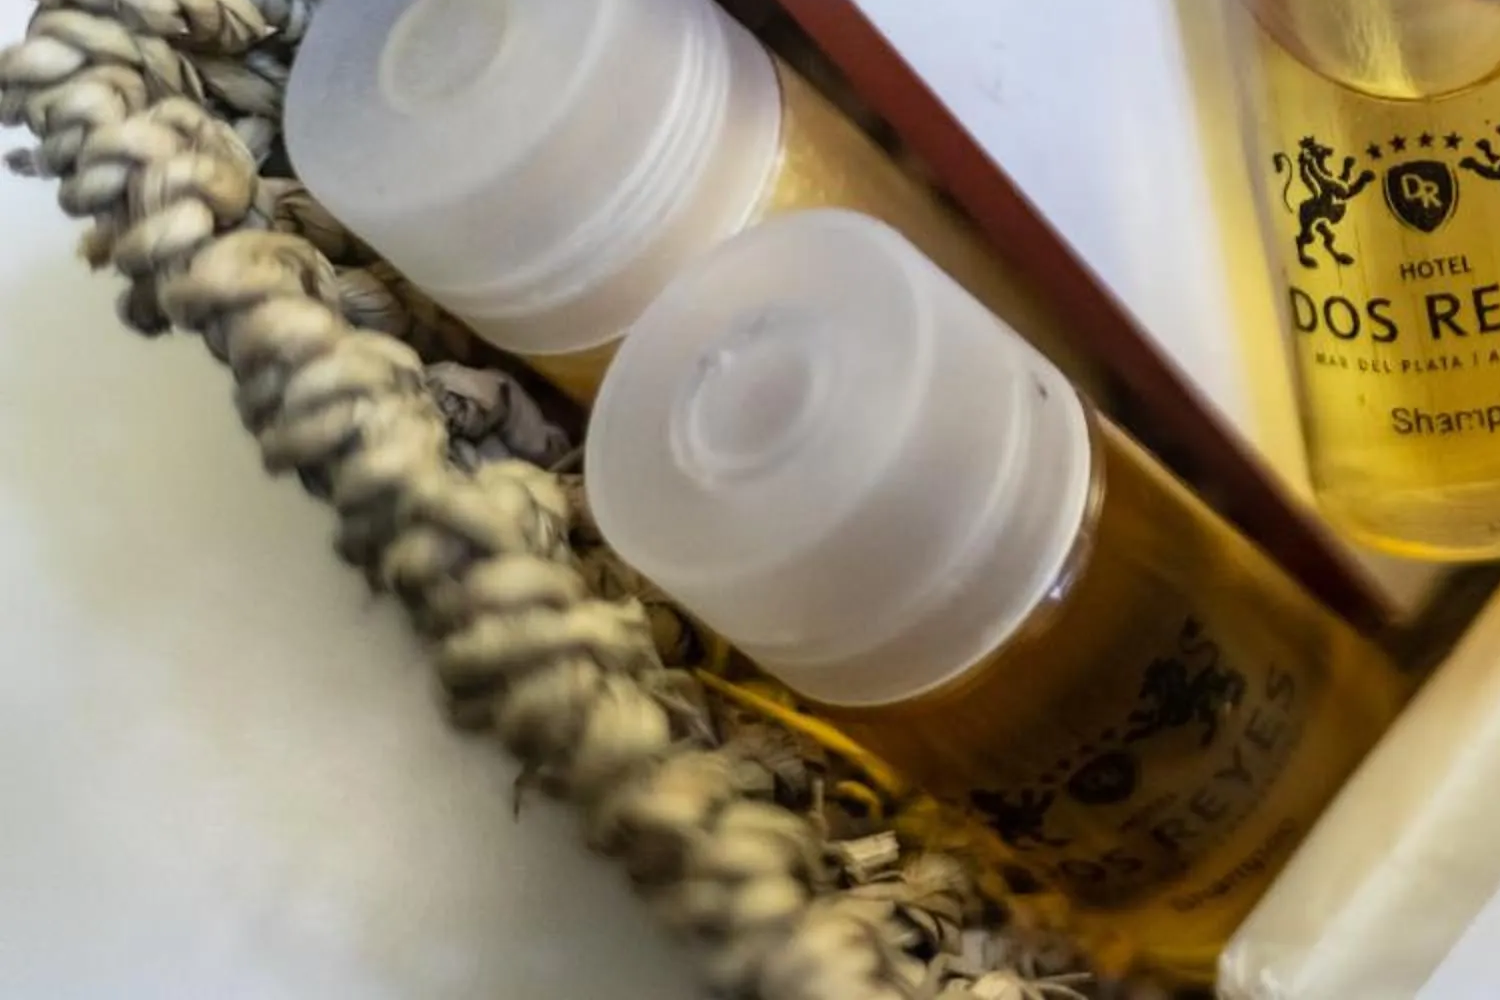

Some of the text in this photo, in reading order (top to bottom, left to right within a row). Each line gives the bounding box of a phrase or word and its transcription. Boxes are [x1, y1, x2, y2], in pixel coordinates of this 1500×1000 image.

[1401, 173, 1442, 209] DR
[1400, 255, 1473, 281] HOTEL
[1289, 286, 1398, 343] DOS
[1315, 352, 1349, 370] MAR
[1358, 357, 1392, 374] DEL
[1402, 355, 1464, 376] PLATA
